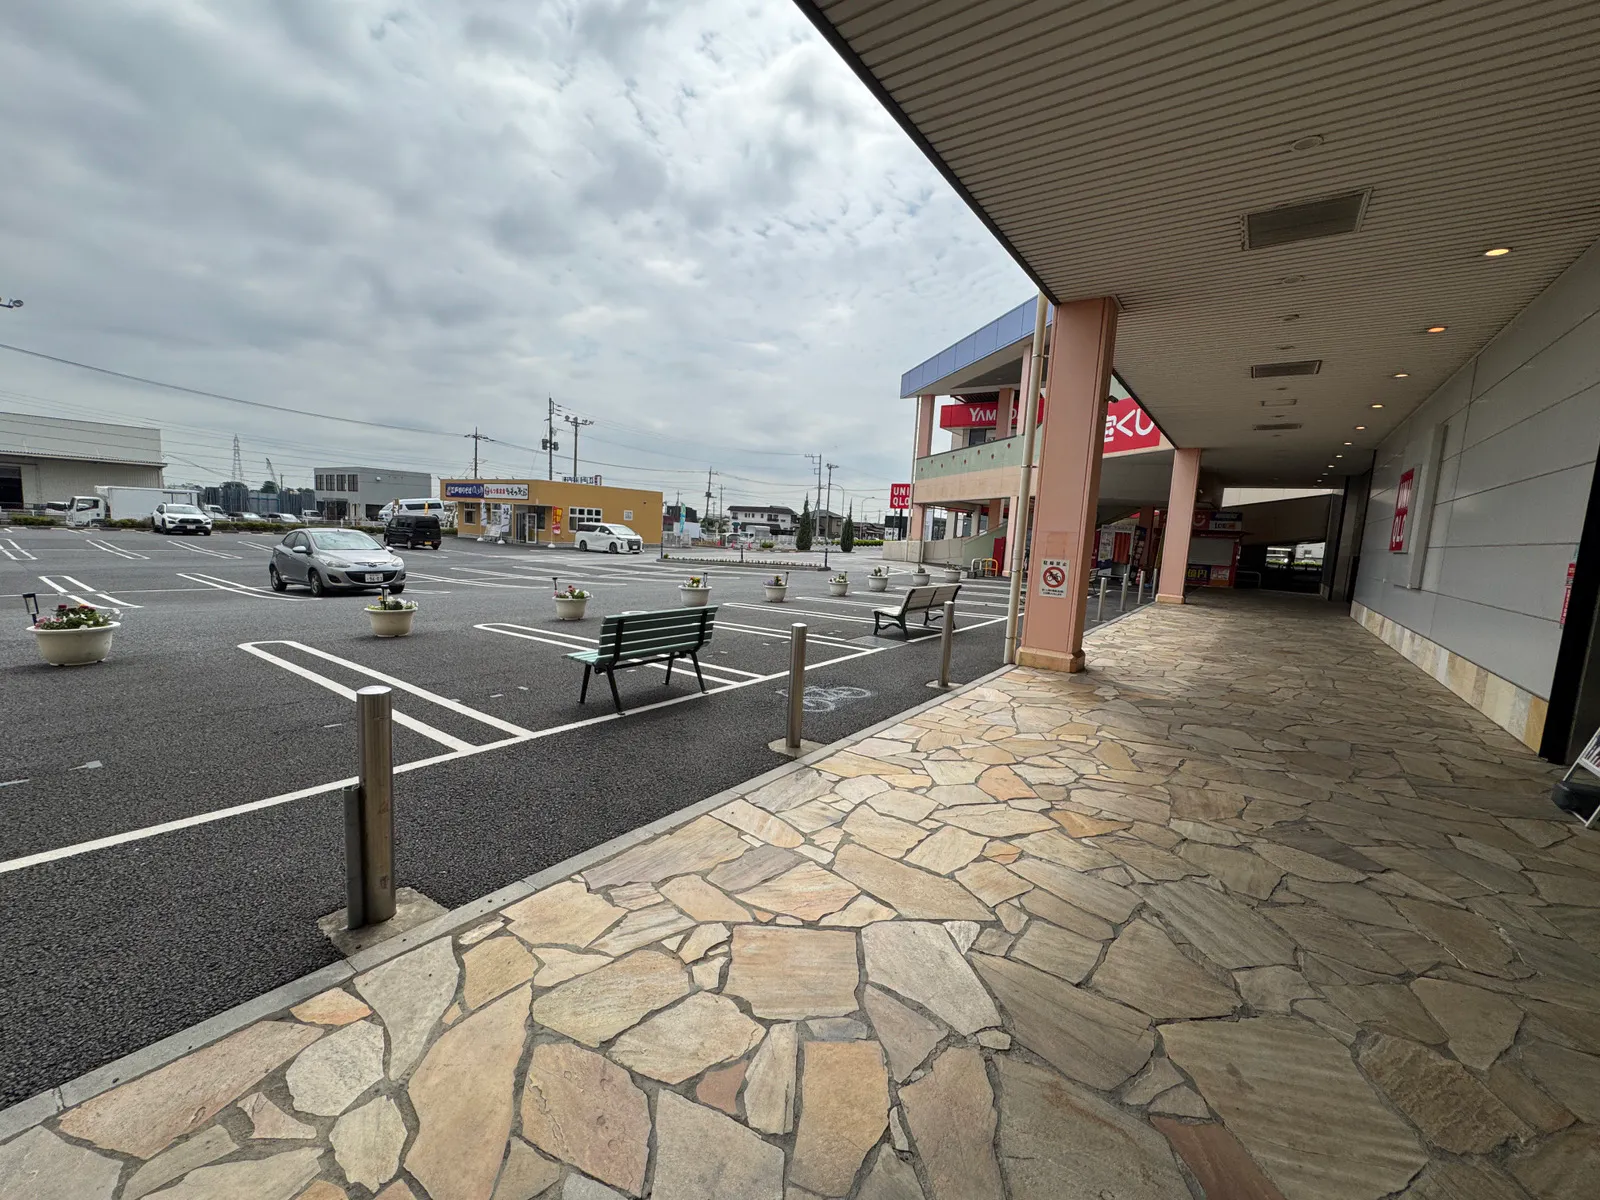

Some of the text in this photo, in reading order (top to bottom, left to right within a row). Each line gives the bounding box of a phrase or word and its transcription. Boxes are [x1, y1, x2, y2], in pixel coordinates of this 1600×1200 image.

[893, 486, 910, 496] UNI
[1398, 478, 1413, 510] UNI
[1392, 514, 1406, 548] QLO
